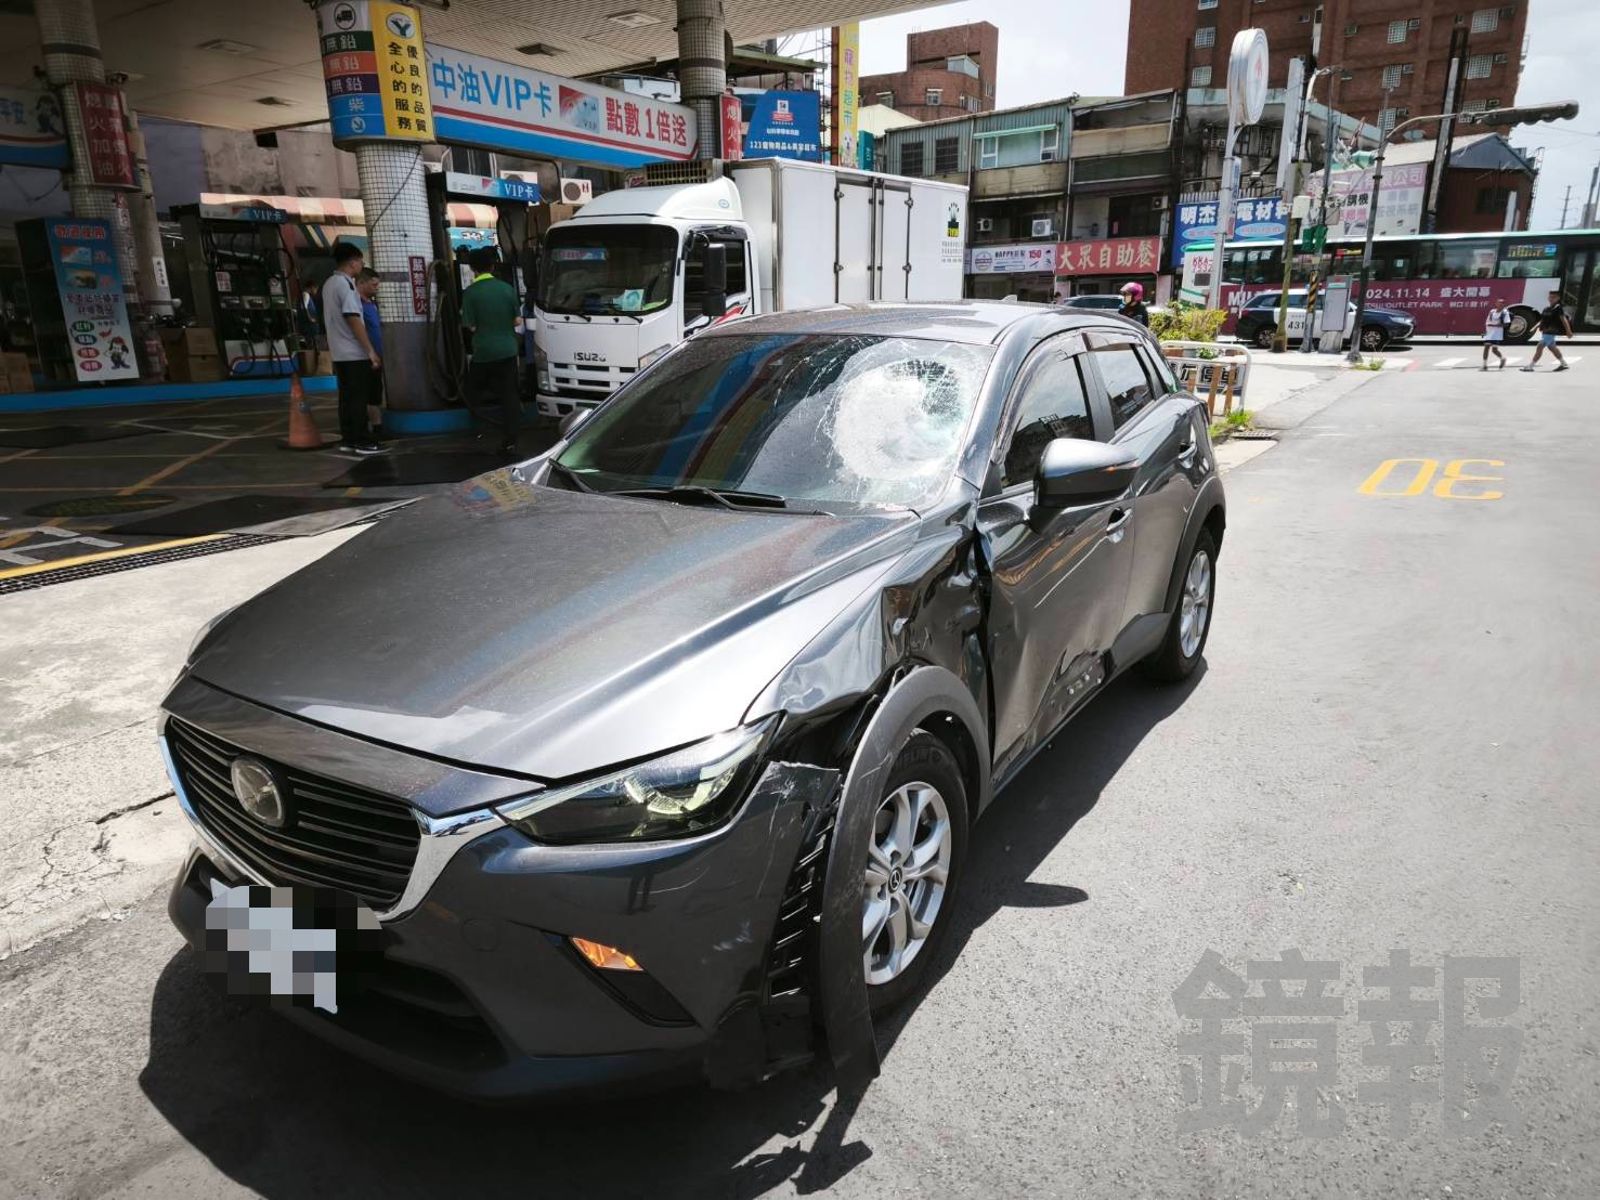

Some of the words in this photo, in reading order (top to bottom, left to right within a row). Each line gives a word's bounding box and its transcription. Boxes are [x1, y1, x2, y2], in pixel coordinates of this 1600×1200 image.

[387, 41, 412, 130] 全心的服務
[406, 44, 427, 132] 優良的品質
[432, 57, 552, 118] 中油VIP卡
[606, 97, 688, 146] 點數1倍送
[504, 183, 534, 199] VIP卡
[1366, 287, 1430, 300] 024.11.14
[573, 352, 606, 362] ISUZU
